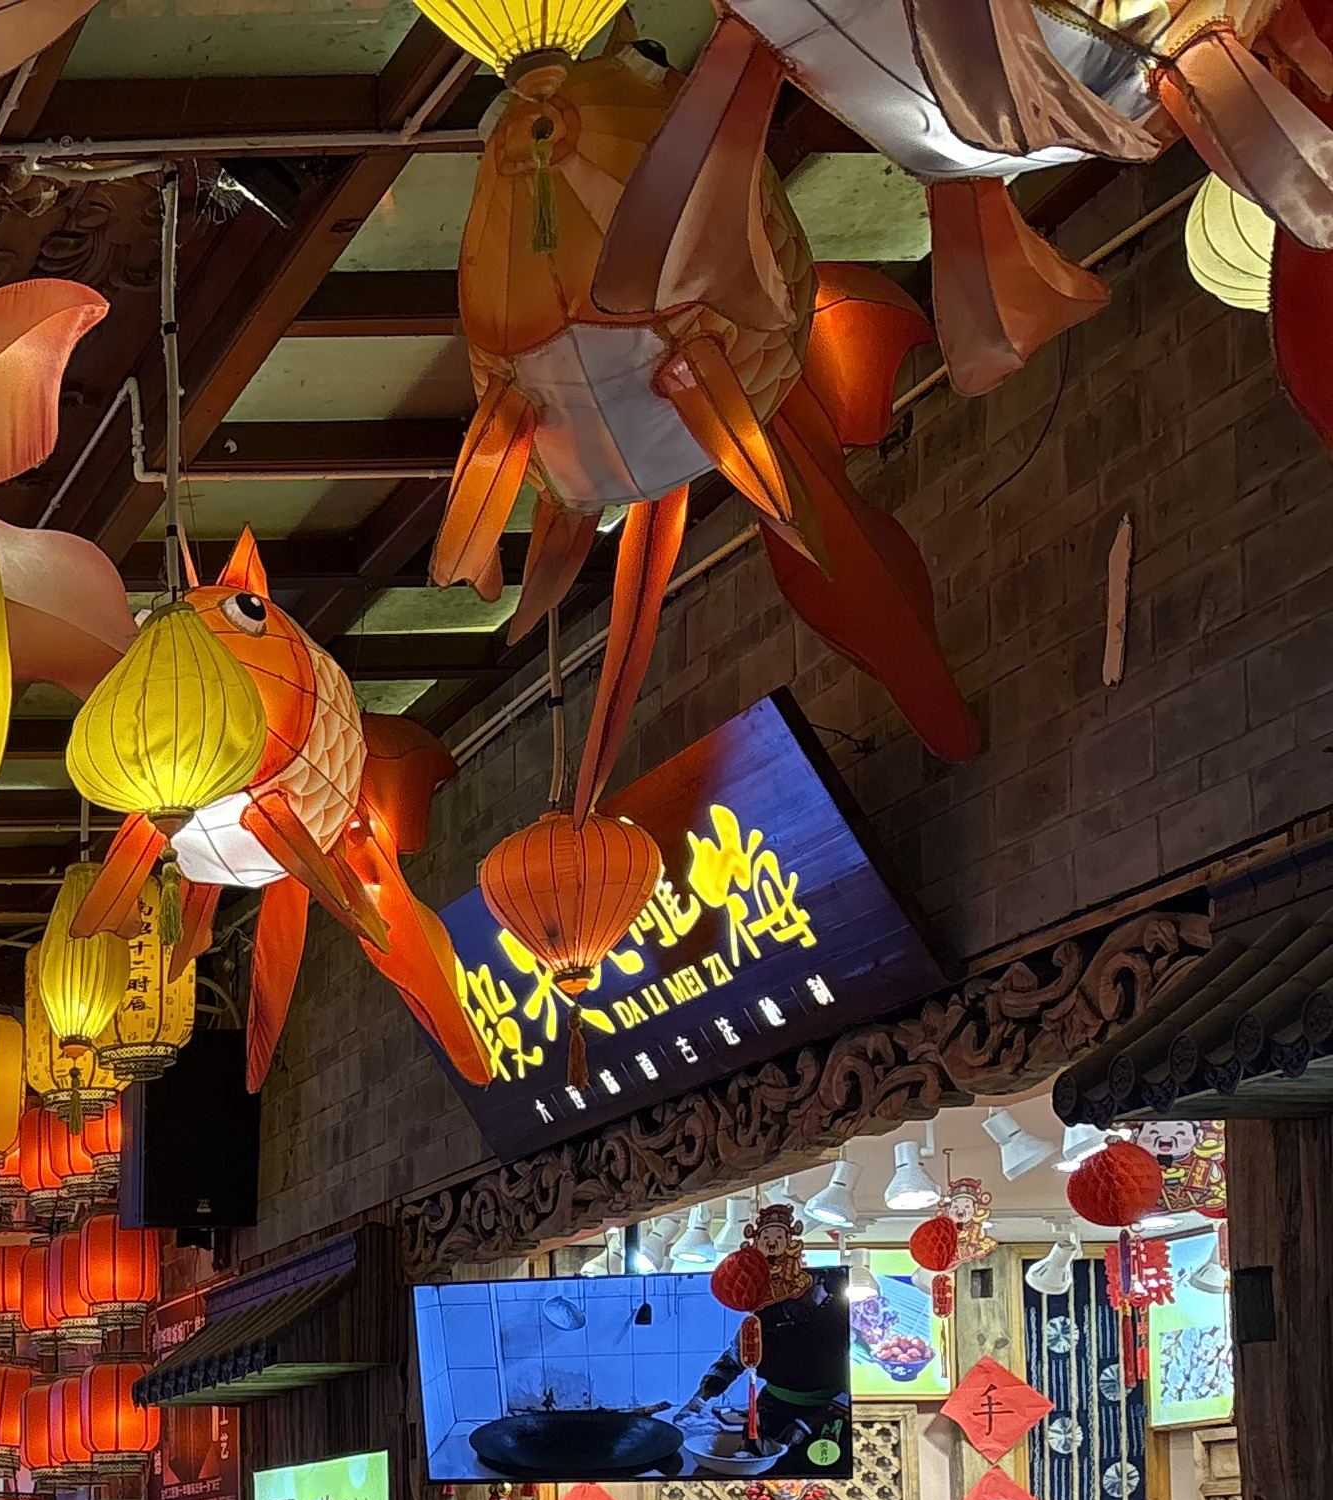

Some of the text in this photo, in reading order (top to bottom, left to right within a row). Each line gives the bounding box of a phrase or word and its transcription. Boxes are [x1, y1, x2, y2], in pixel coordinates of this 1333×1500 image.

[612, 949, 734, 1030] DA LI MEI ZI
